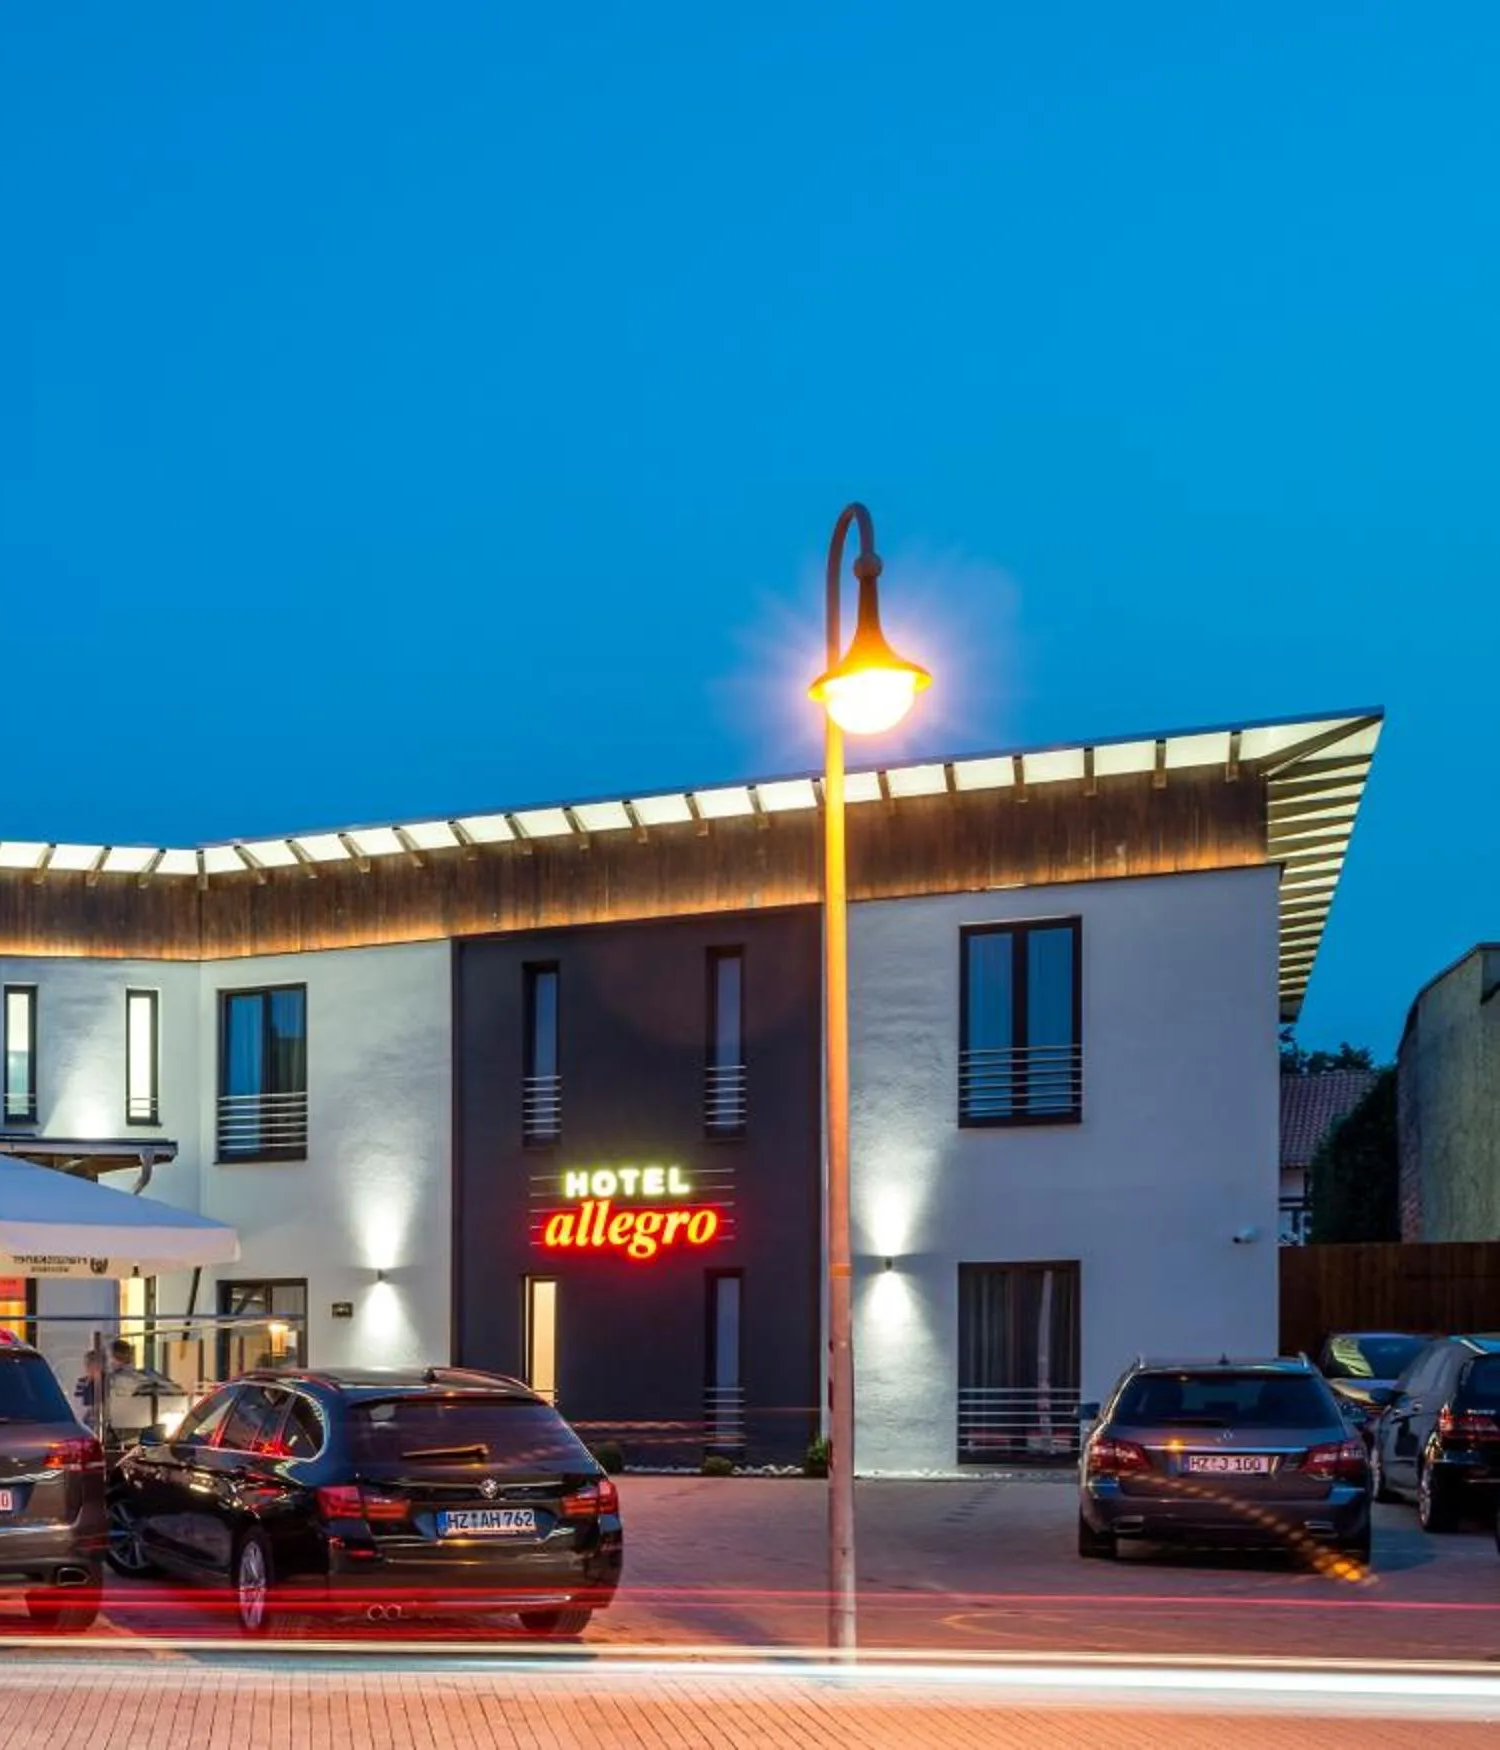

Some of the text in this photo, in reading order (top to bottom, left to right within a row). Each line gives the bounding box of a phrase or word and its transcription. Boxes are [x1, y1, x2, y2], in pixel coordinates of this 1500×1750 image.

[564, 1166, 691, 1198] HOTEL
[544, 1199, 718, 1259] allegro
[448, 1512, 469, 1529] HZ
